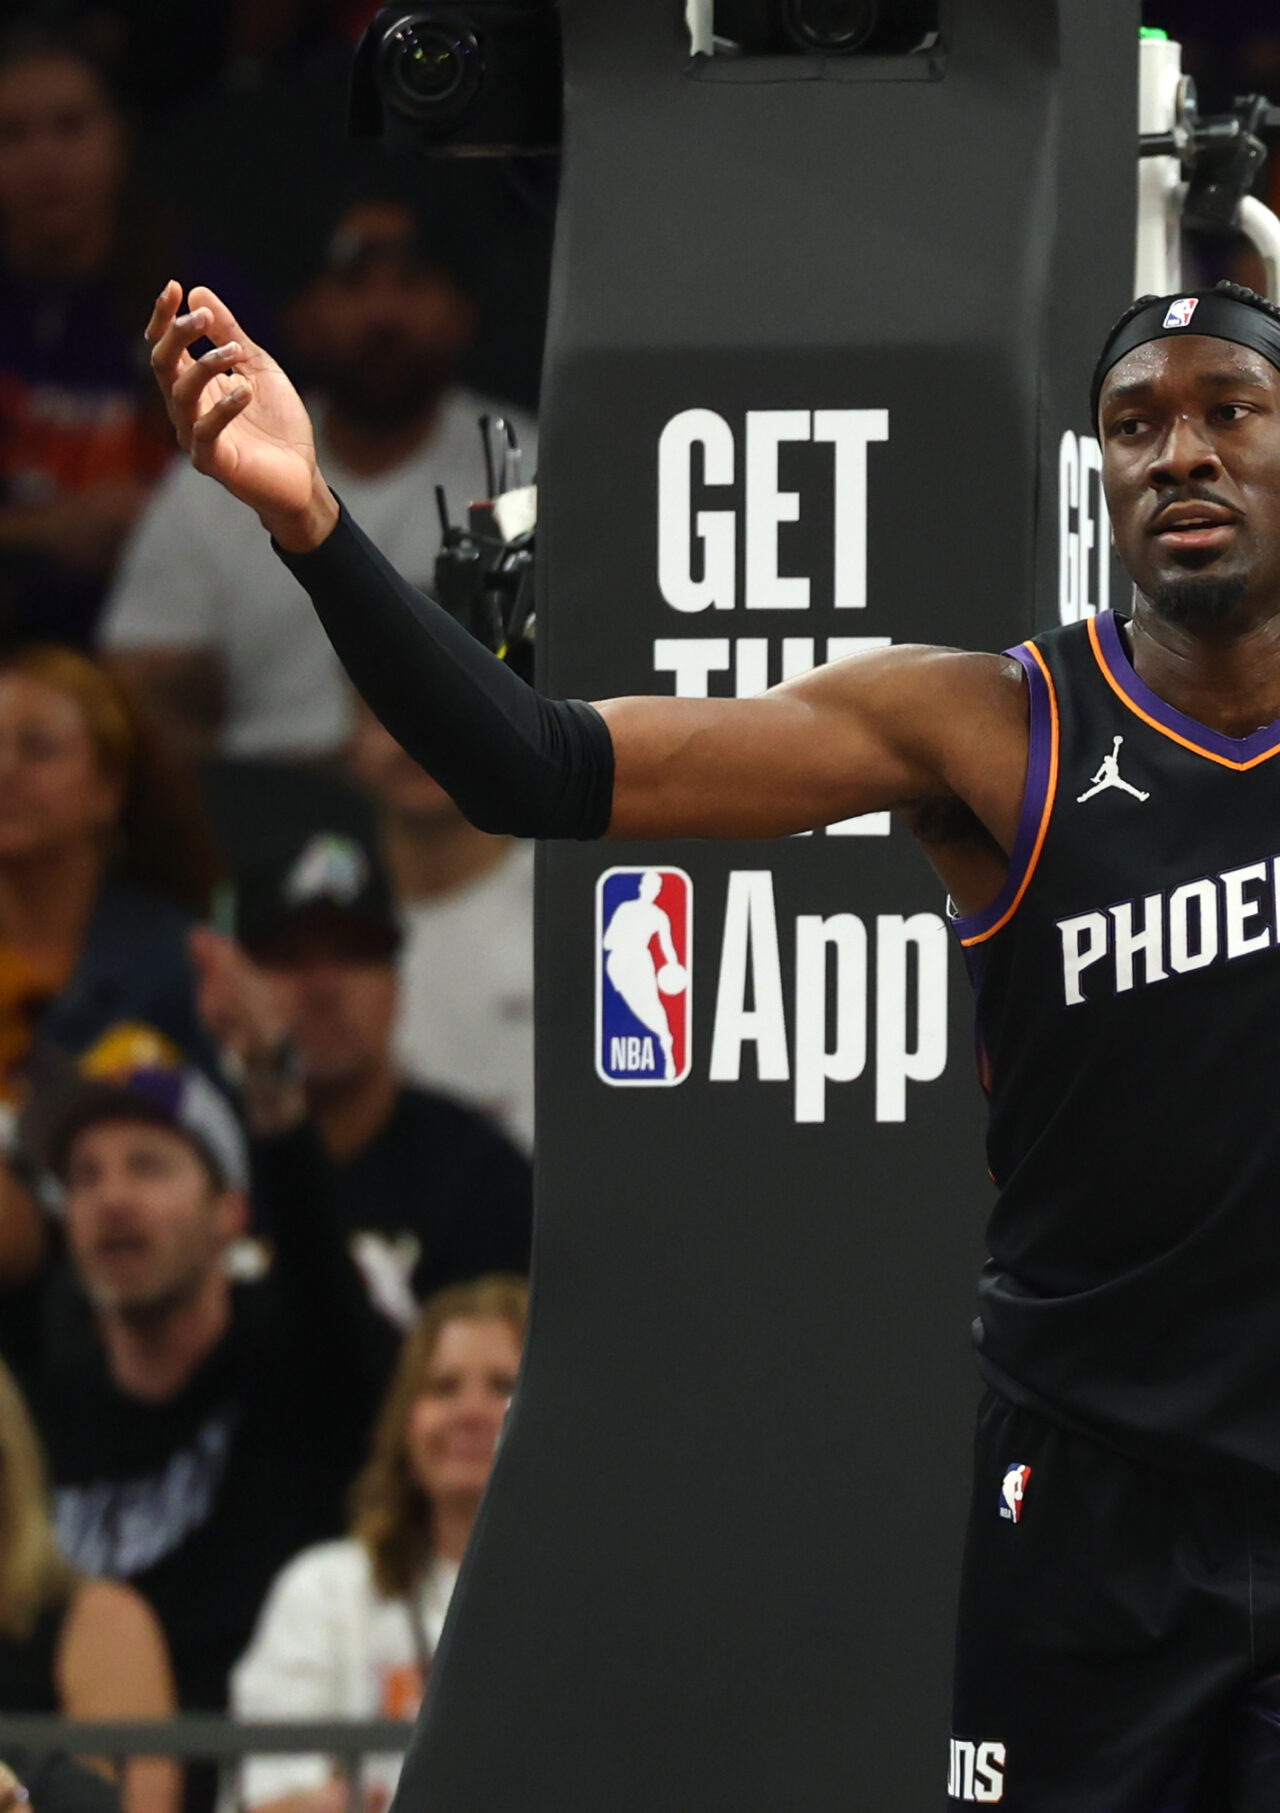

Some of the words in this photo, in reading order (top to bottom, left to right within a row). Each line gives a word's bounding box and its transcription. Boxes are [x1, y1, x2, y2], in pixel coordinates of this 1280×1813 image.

[658, 408, 889, 613] GET
[611, 1036, 655, 1071] NBA
[709, 870, 948, 1123] App
